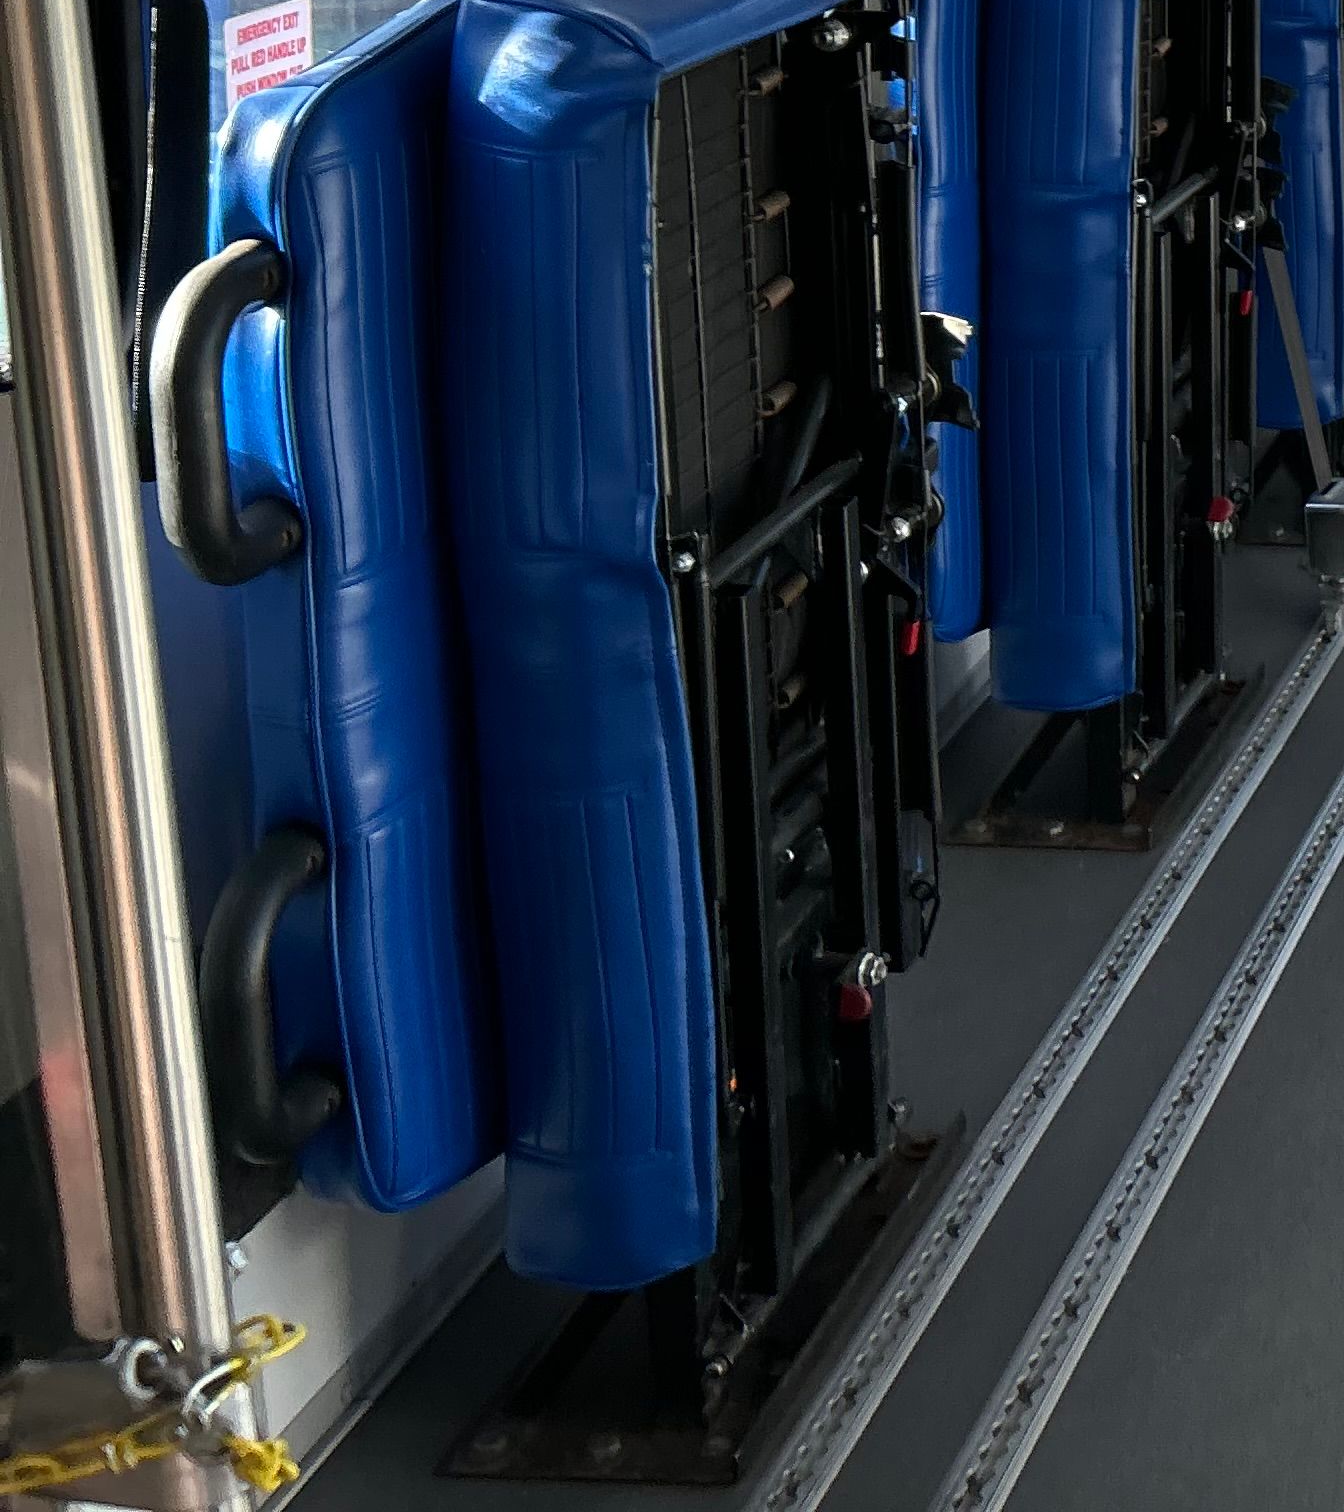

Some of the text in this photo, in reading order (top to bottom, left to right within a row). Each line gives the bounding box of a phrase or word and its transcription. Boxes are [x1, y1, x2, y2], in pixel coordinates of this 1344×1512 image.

[237, 11, 298, 45] EMERGENCY EXIT
[232, 36, 306, 75] PULL RED HANDLE UP
